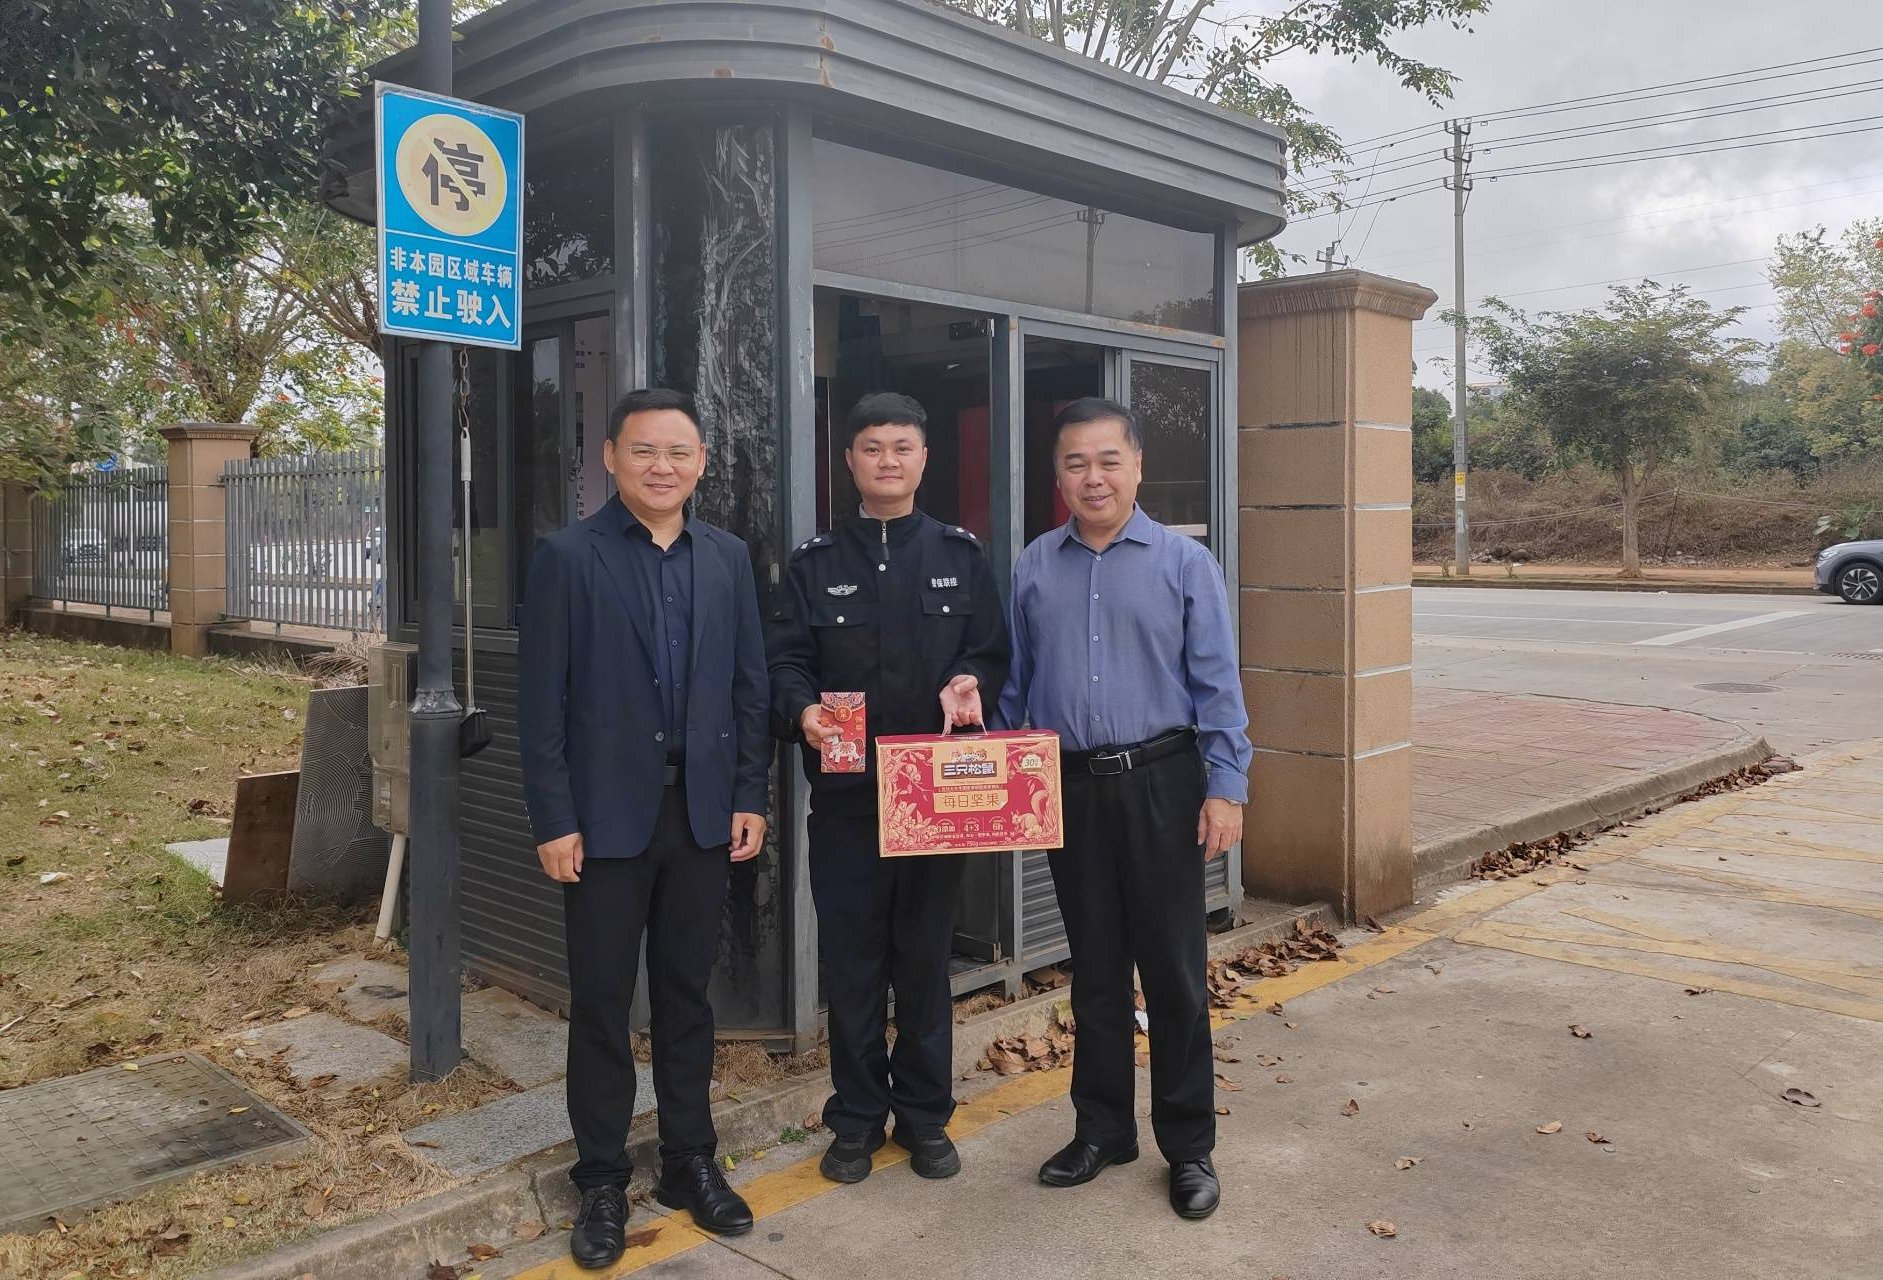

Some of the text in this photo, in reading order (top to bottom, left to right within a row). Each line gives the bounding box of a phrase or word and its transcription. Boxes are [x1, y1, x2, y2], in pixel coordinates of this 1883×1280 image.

[422, 137, 486, 211] 停
[390, 246, 513, 289] 非本园区域车辆
[391, 279, 511, 329] 禁止驶入
[943, 763, 995, 776] 三只松鼠
[942, 793, 999, 808] 每日坚果
[963, 823, 980, 832] 4+3
